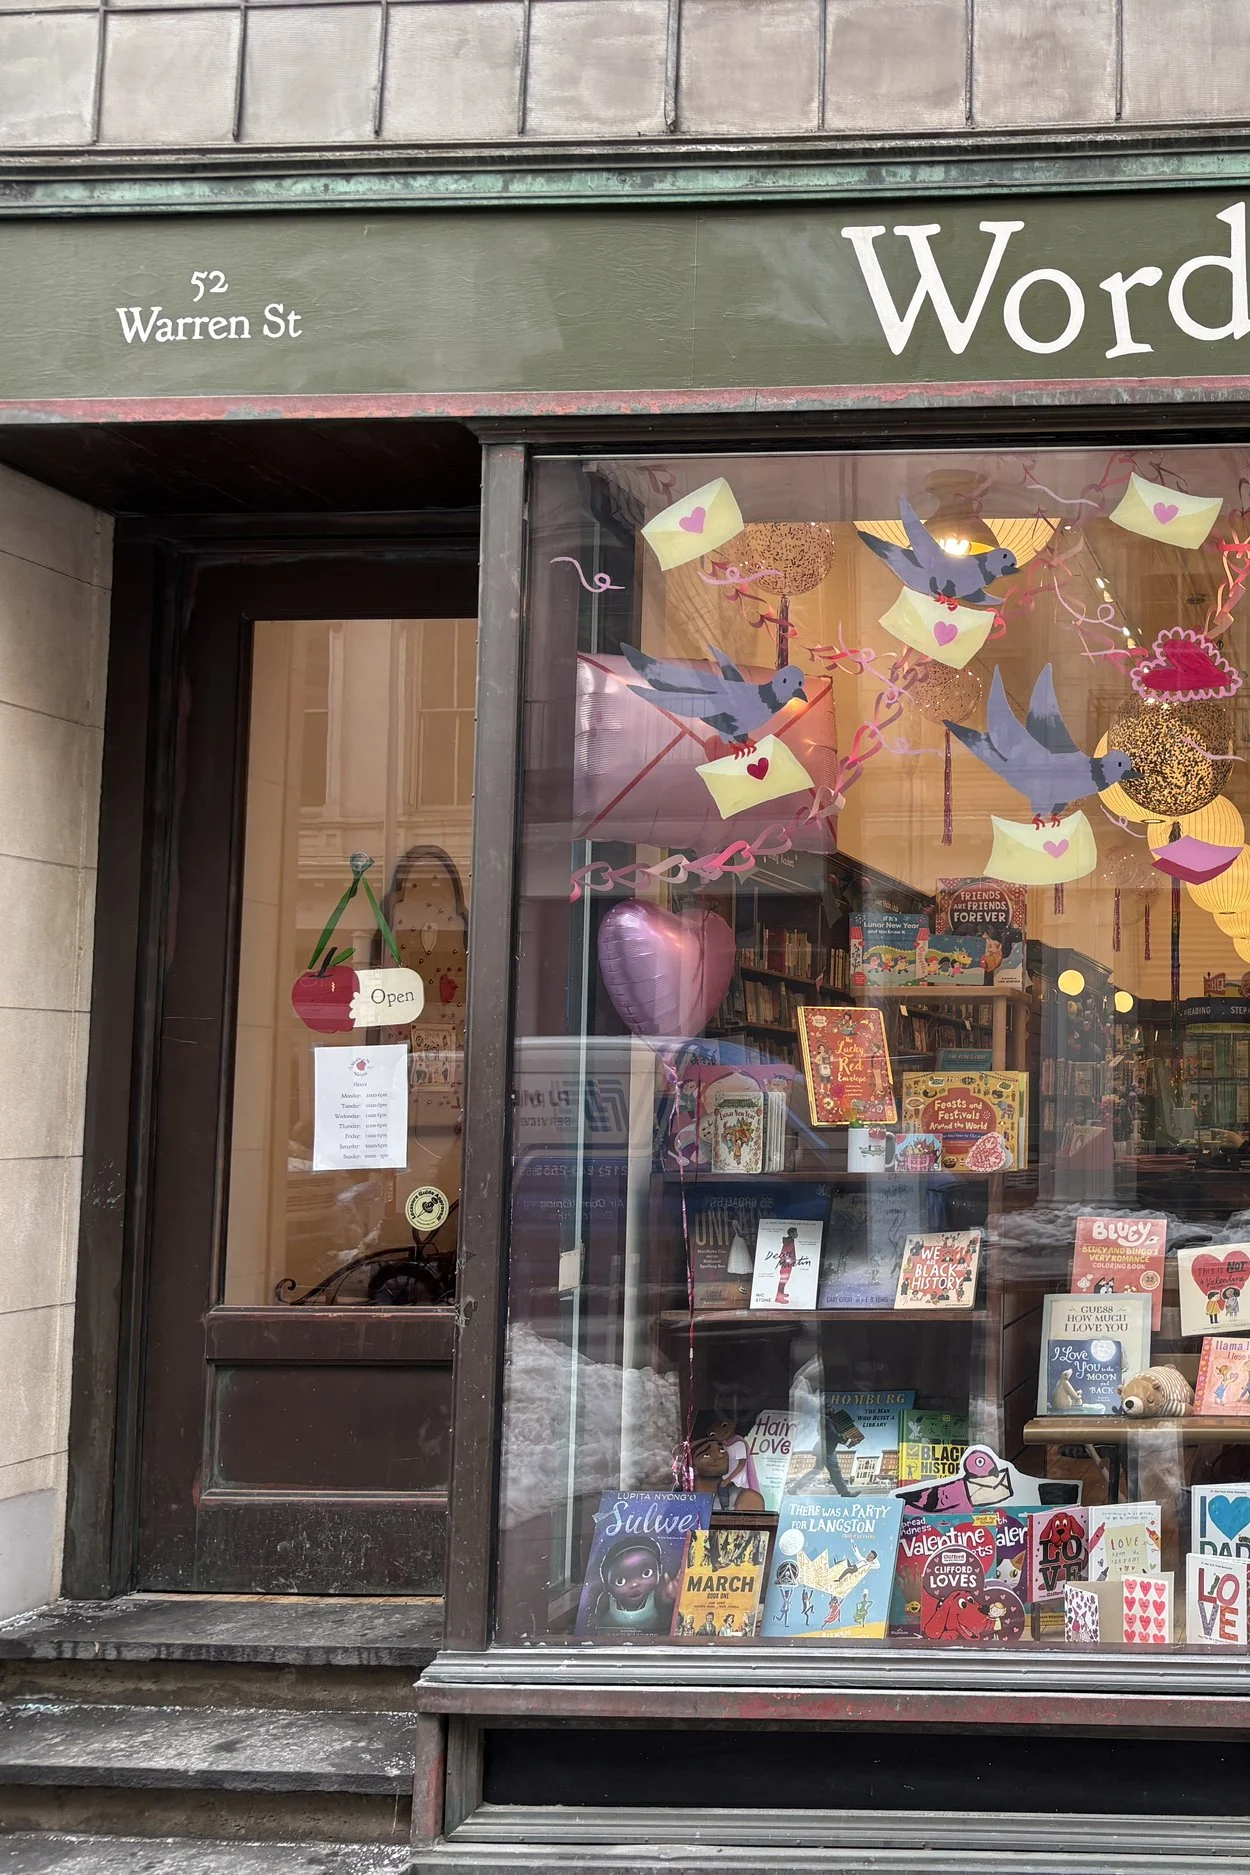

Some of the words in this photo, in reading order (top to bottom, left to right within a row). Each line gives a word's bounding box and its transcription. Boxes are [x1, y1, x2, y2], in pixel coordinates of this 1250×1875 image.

[190, 271, 228, 302] 52
[116, 307, 251, 344] Warren
[262, 304, 303, 339] St
[960, 890, 1001, 901] FRIENDS
[953, 902, 967, 910] ARE
[953, 911, 1007, 923] FOREVER
[863, 921, 884, 929] Lunar
[370, 987, 415, 1009] Open
[1230, 1006, 1247, 1015] STEP
[835, 1041, 865, 1058] Lucky
[839, 1057, 863, 1075] Red
[837, 1072, 867, 1083] Envelope
[934, 1098, 967, 1111] Feasts
[938, 1110, 980, 1121] Festivals
[929, 1122, 953, 1131] Around
[965, 1122, 988, 1130] World
[1092, 1221, 1152, 1247] BLUEY
[921, 1247, 941, 1260] WE
[1082, 1246, 1108, 1254] BLUEY
[1111, 1255, 1150, 1263] ROMANCE
[915, 1263, 957, 1277] BLACK
[1226, 1261, 1248, 1273] NOT
[911, 1277, 964, 1289] HISTORY
[1080, 1306, 1113, 1314] GUESS
[1067, 1314, 1092, 1322] HOW
[1095, 1314, 1127, 1322] MUCH
[1064, 1323, 1068, 1332] I
[1073, 1323, 1103, 1332] LOVE
[1104, 1323, 1129, 1332] YOU
[1215, 1340, 1243, 1351] llama
[756, 1416, 797, 1437] Hair
[749, 1437, 791, 1455] Love
[654, 1493, 697, 1501] NYONG'O
[789, 1503, 820, 1517] THERE
[822, 1507, 841, 1517] WAS
[842, 1510, 850, 1518] A
[851, 1503, 891, 1519] PARTY
[1200, 1496, 1207, 1538] I
[605, 1500, 697, 1536] Sulwe
[791, 1520, 808, 1530] FOR
[808, 1519, 876, 1533] LANGSTON
[899, 1527, 985, 1557] Valentine
[1110, 1536, 1139, 1551] LOVE
[934, 1565, 973, 1575] CLIFFORD
[687, 1575, 755, 1592] MARCH
[930, 1574, 977, 1588] LOVES
